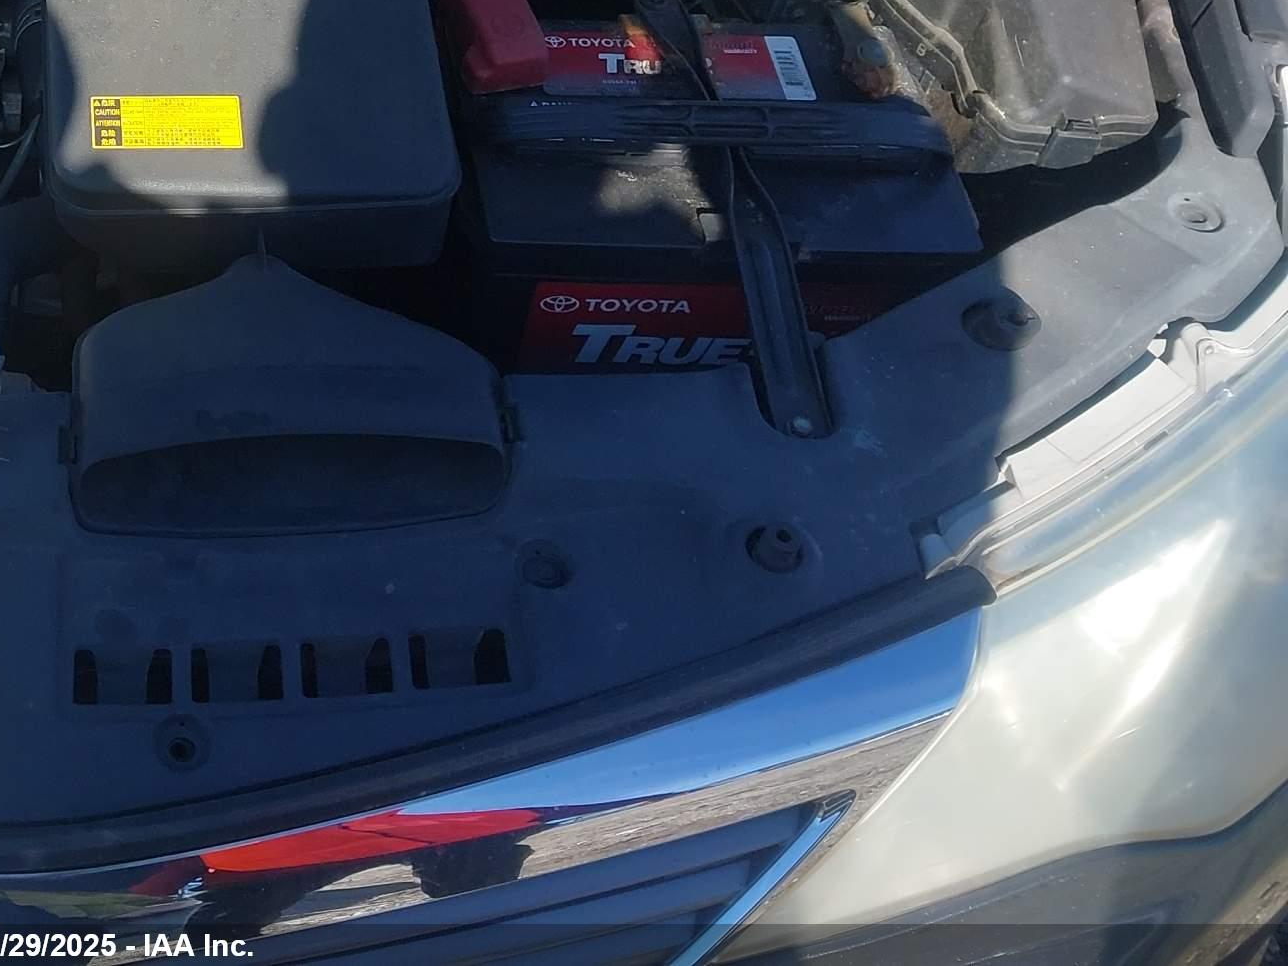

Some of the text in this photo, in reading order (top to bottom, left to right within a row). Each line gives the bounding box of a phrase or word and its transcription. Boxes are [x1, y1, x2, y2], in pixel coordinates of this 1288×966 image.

[568, 37, 635, 48] TOYOTA
[95, 108, 120, 116] CAUTION
[95, 119, 121, 127] ATTENTION
[585, 298, 691, 314] TOYOTA
[571, 323, 755, 365] TRUE
